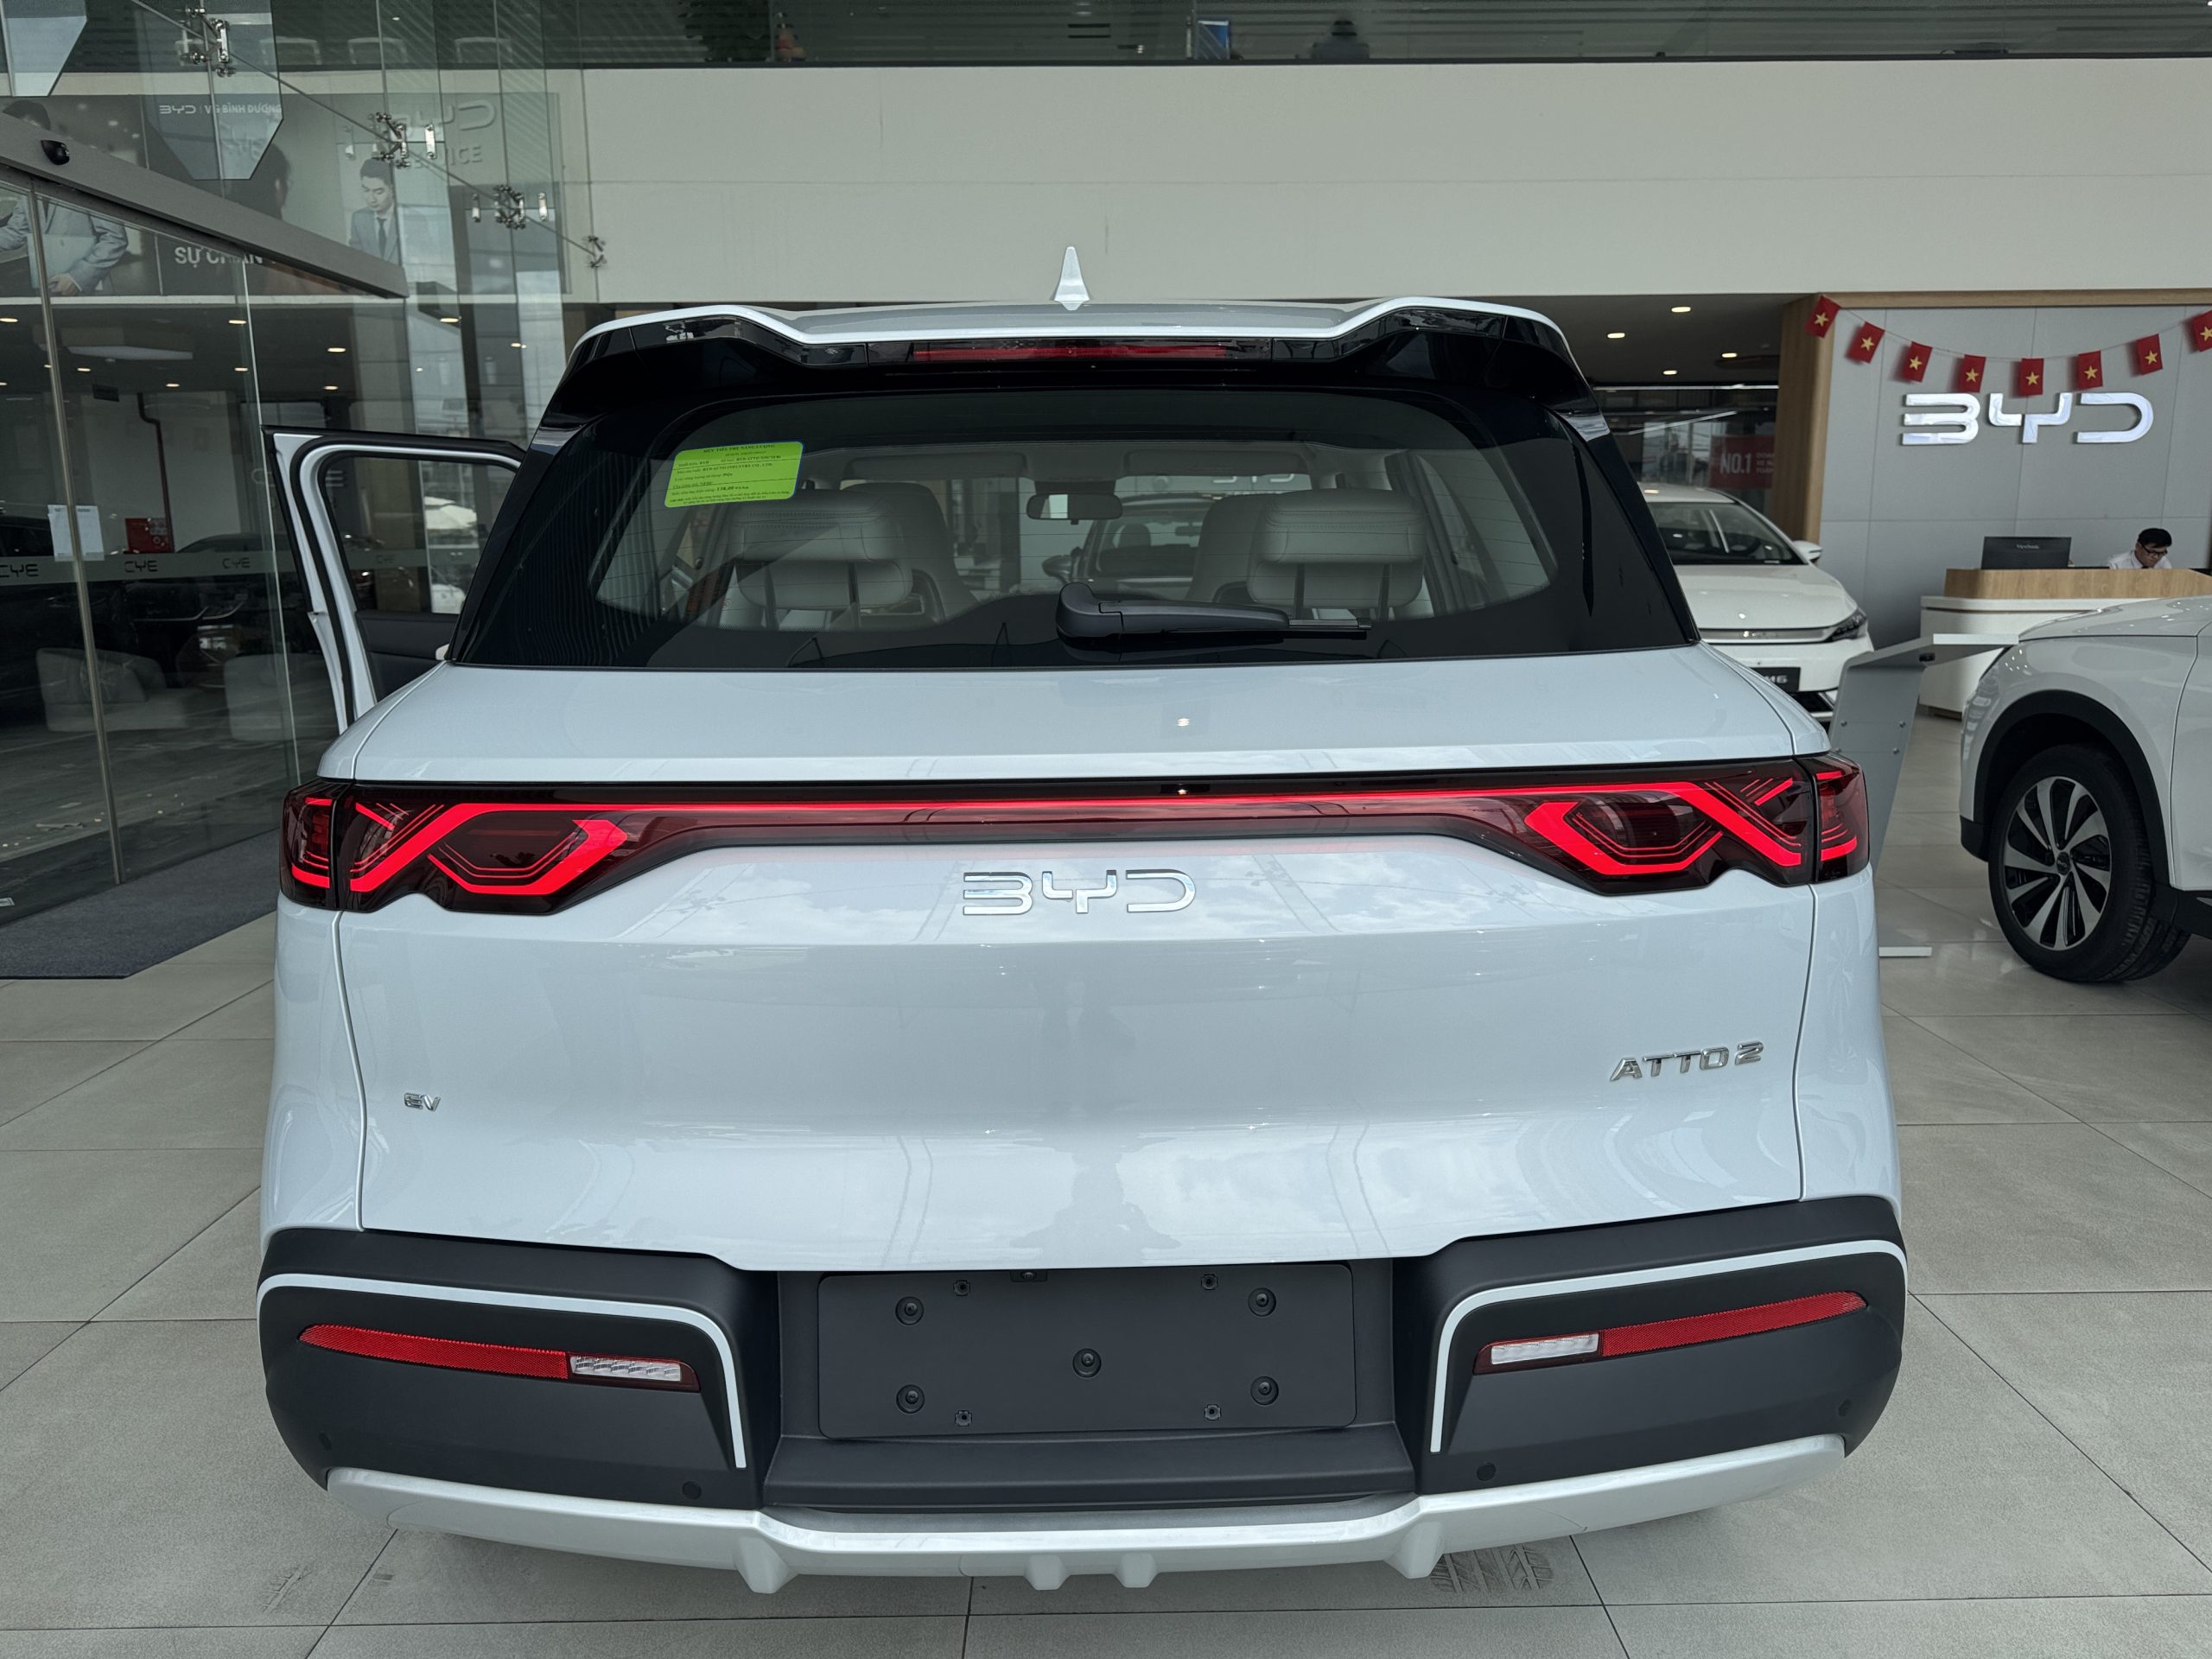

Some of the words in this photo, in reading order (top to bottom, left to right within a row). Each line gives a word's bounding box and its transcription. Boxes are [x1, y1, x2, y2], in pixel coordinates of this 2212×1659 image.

[159, 105, 196, 114] BYD
[221, 102, 245, 113] BÌNH
[1902, 392, 2154, 445] BYD
[1719, 453, 1752, 474] NO.1
[963, 868, 1196, 915] BYD
[1609, 1046, 1729, 1081] ATTO
[1734, 1040, 1764, 1065] 2
[404, 1092, 442, 1112] EV
